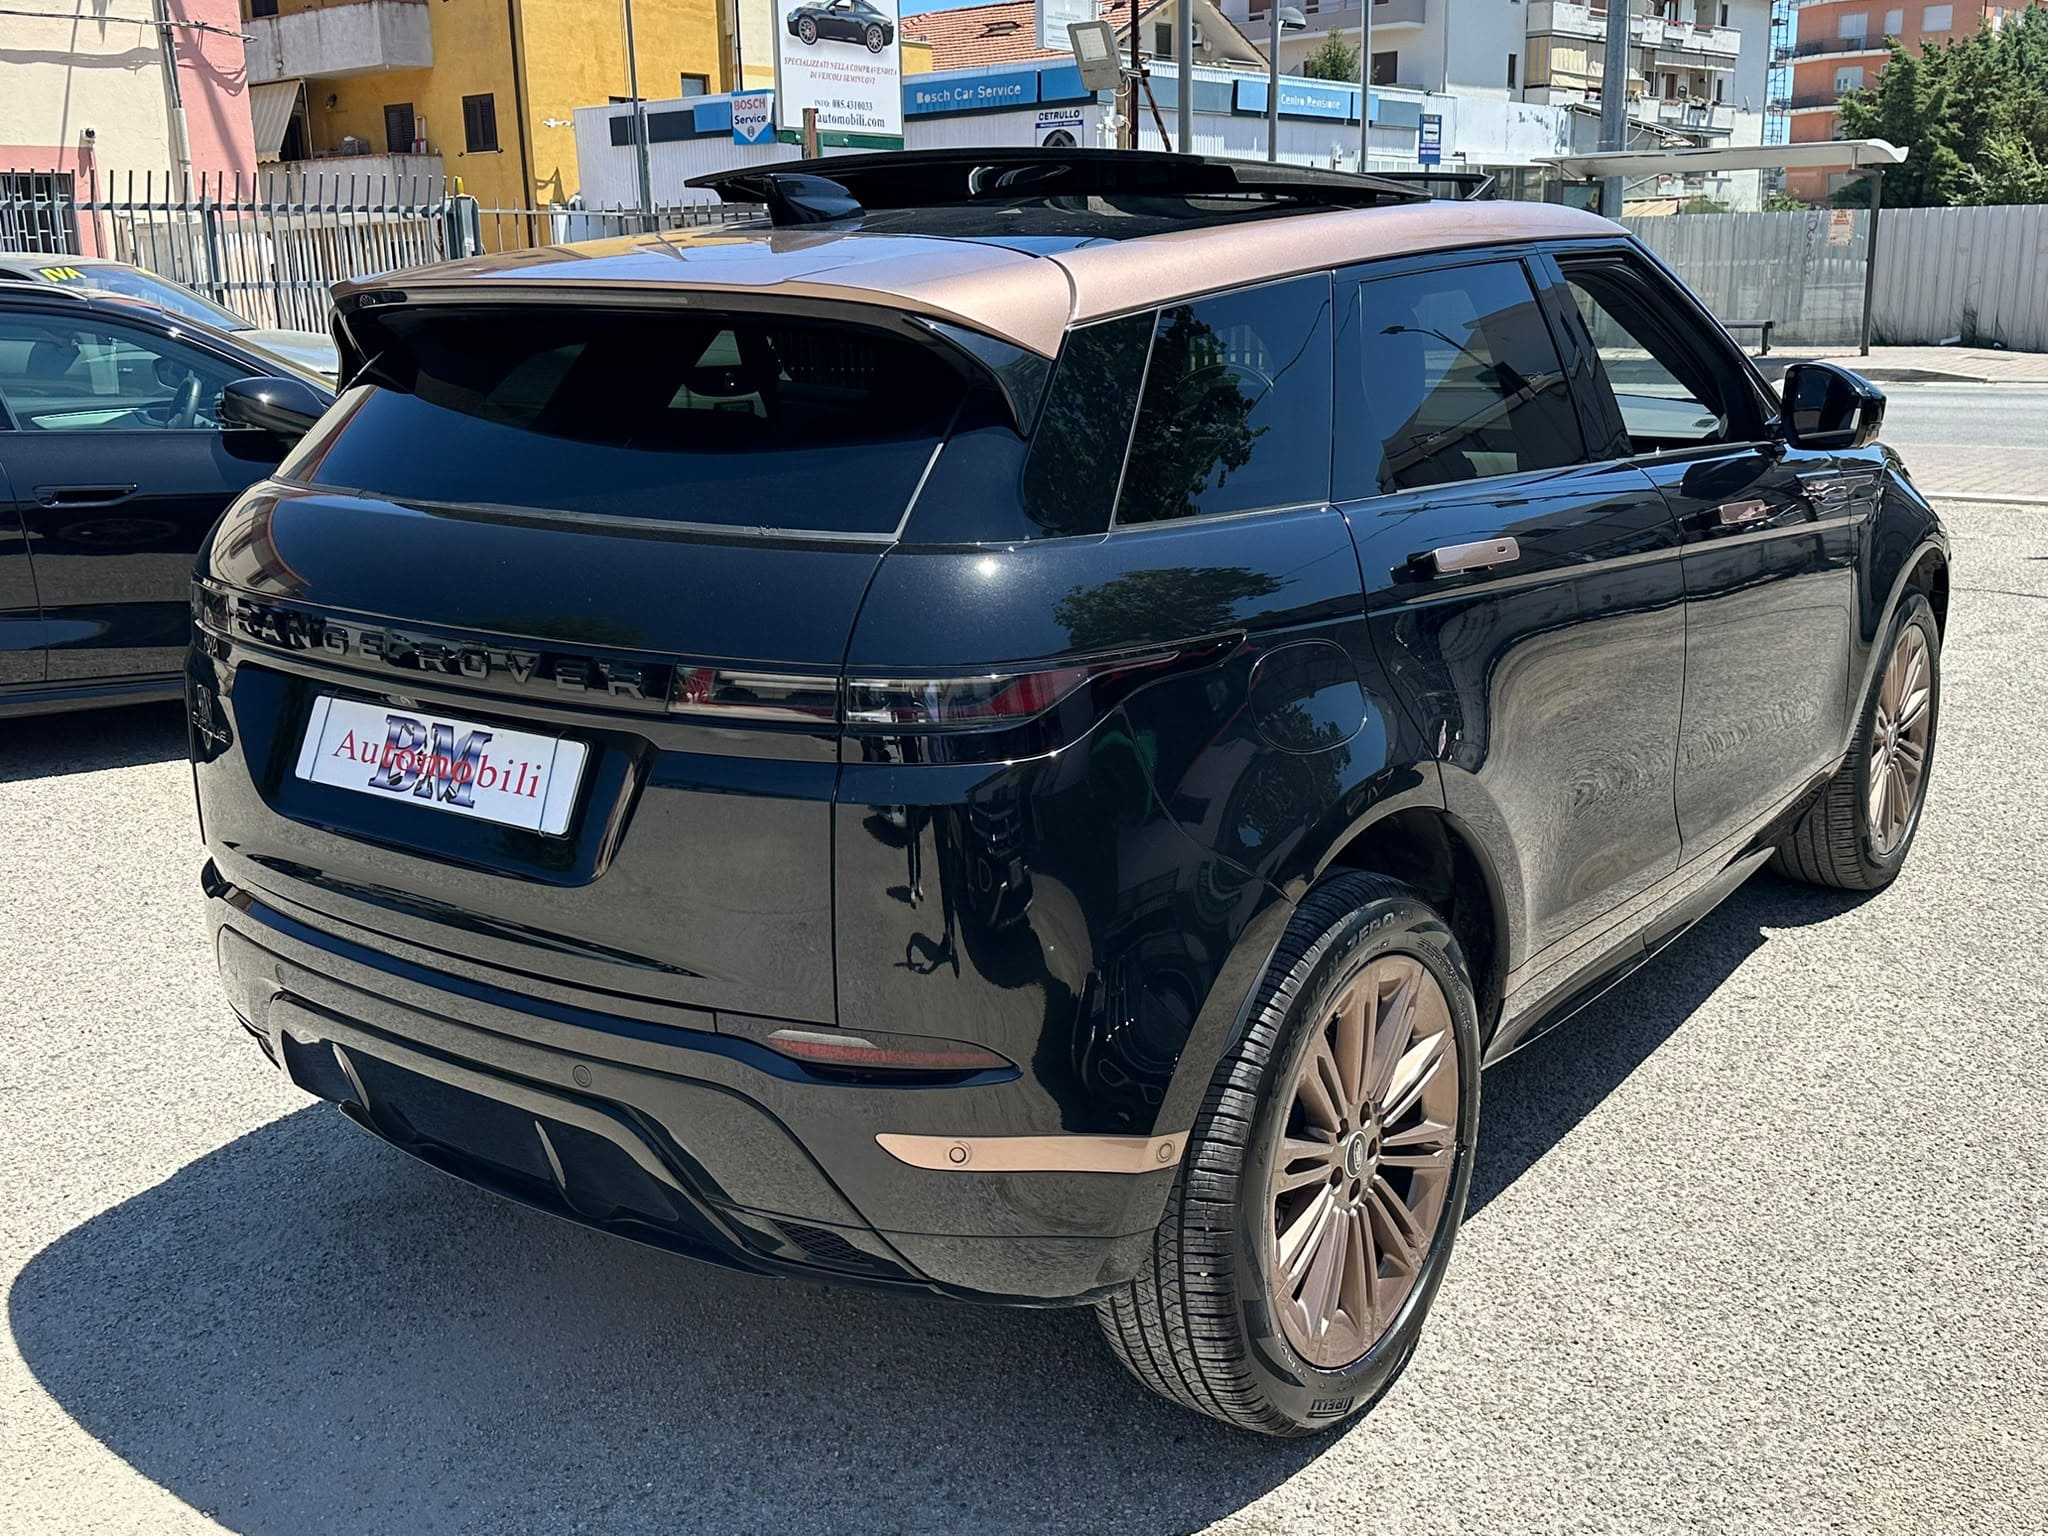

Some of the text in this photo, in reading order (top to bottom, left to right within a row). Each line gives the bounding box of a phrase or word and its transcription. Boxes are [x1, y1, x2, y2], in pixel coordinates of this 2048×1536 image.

[916, 84, 1021, 104] Bosch Car Service
[1281, 94, 1305, 106] Centro
[734, 98, 766, 110] BOSCH
[734, 114, 767, 125] Service
[1038, 109, 1080, 121] CETRULLO
[234, 600, 647, 699] RANGE ROVER
[332, 729, 543, 798] Automobili
[368, 714, 493, 809] BM
